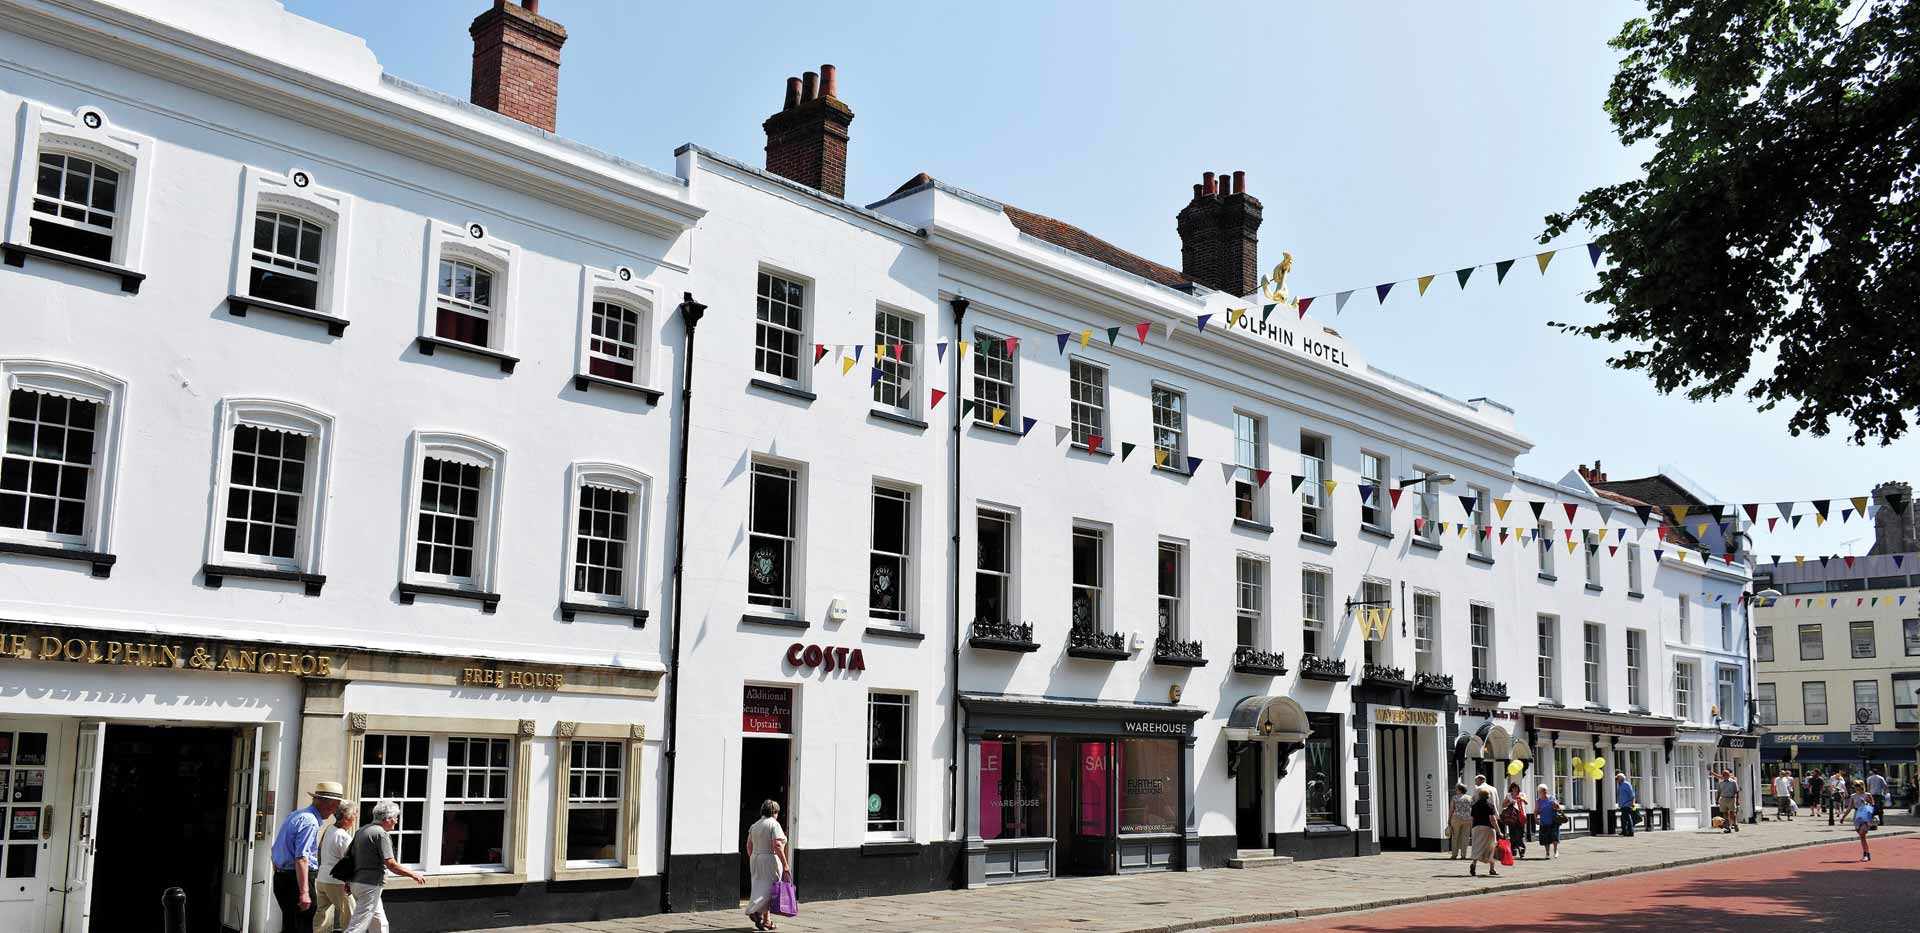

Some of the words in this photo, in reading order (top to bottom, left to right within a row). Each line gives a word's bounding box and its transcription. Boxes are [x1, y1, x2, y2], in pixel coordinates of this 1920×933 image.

[1227, 308, 1293, 347] DOLPHIN
[1304, 337, 1349, 368] HOTEL
[1356, 607, 1393, 641] W
[39, 636, 181, 667] DOLPHIN
[189, 647, 213, 670] &
[218, 649, 332, 677] ANCHOR
[787, 643, 866, 673] COSTA
[463, 668, 504, 685] FREE
[510, 671, 564, 688] HOUSE
[746, 689, 787, 701] Additional
[773, 705, 790, 715] Area
[750, 718, 782, 731] Upstairs
[1125, 722, 1187, 733] WAREHOUSE
[1310, 742, 1327, 768] W
[991, 799, 1041, 807] WAREHOUSE
